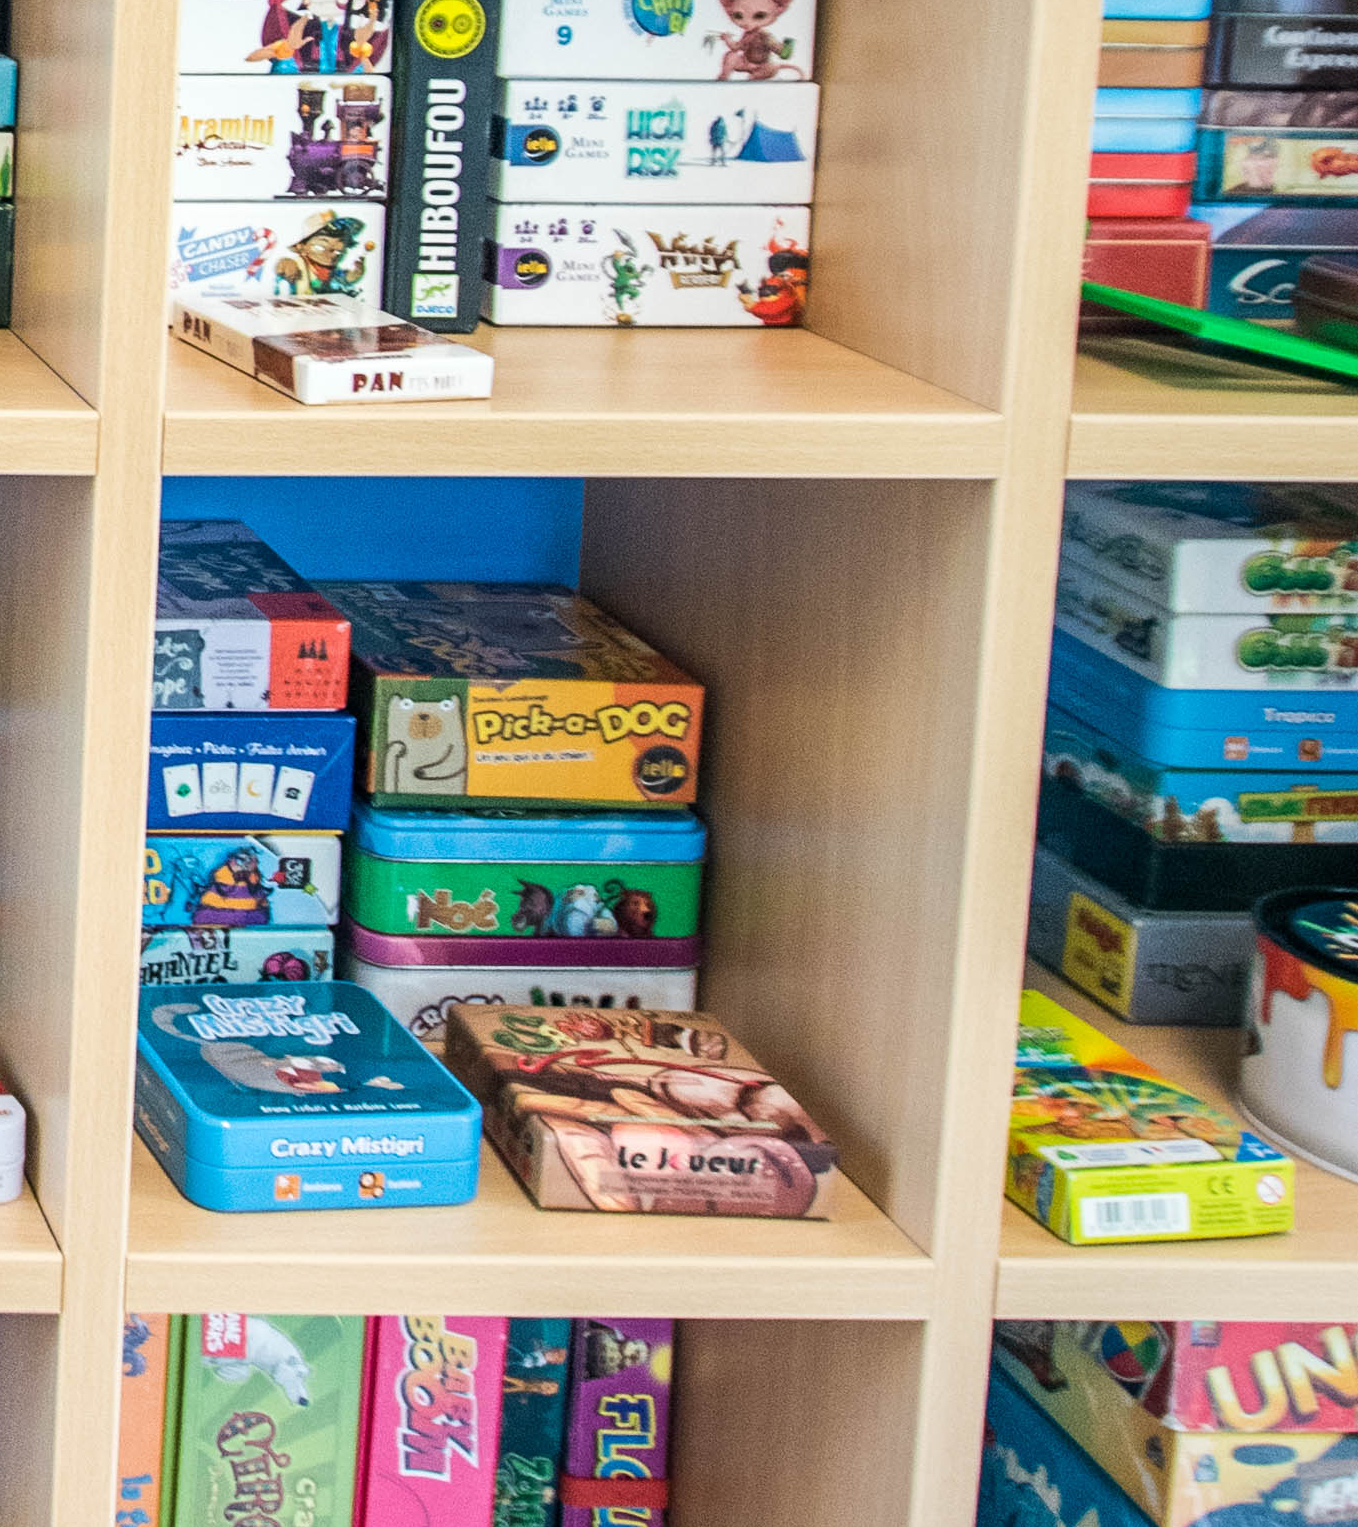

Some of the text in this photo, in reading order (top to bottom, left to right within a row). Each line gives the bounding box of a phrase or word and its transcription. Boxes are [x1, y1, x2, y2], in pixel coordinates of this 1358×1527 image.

[418, 78, 468, 273] HIBOUFOU
[184, 228, 252, 258] CANDY
[197, 250, 263, 278] CHASER
[352, 371, 404, 393] PAN
[270, 1133, 426, 1159] Crazy Mistigri
[1206, 1324, 1358, 1432] UN
